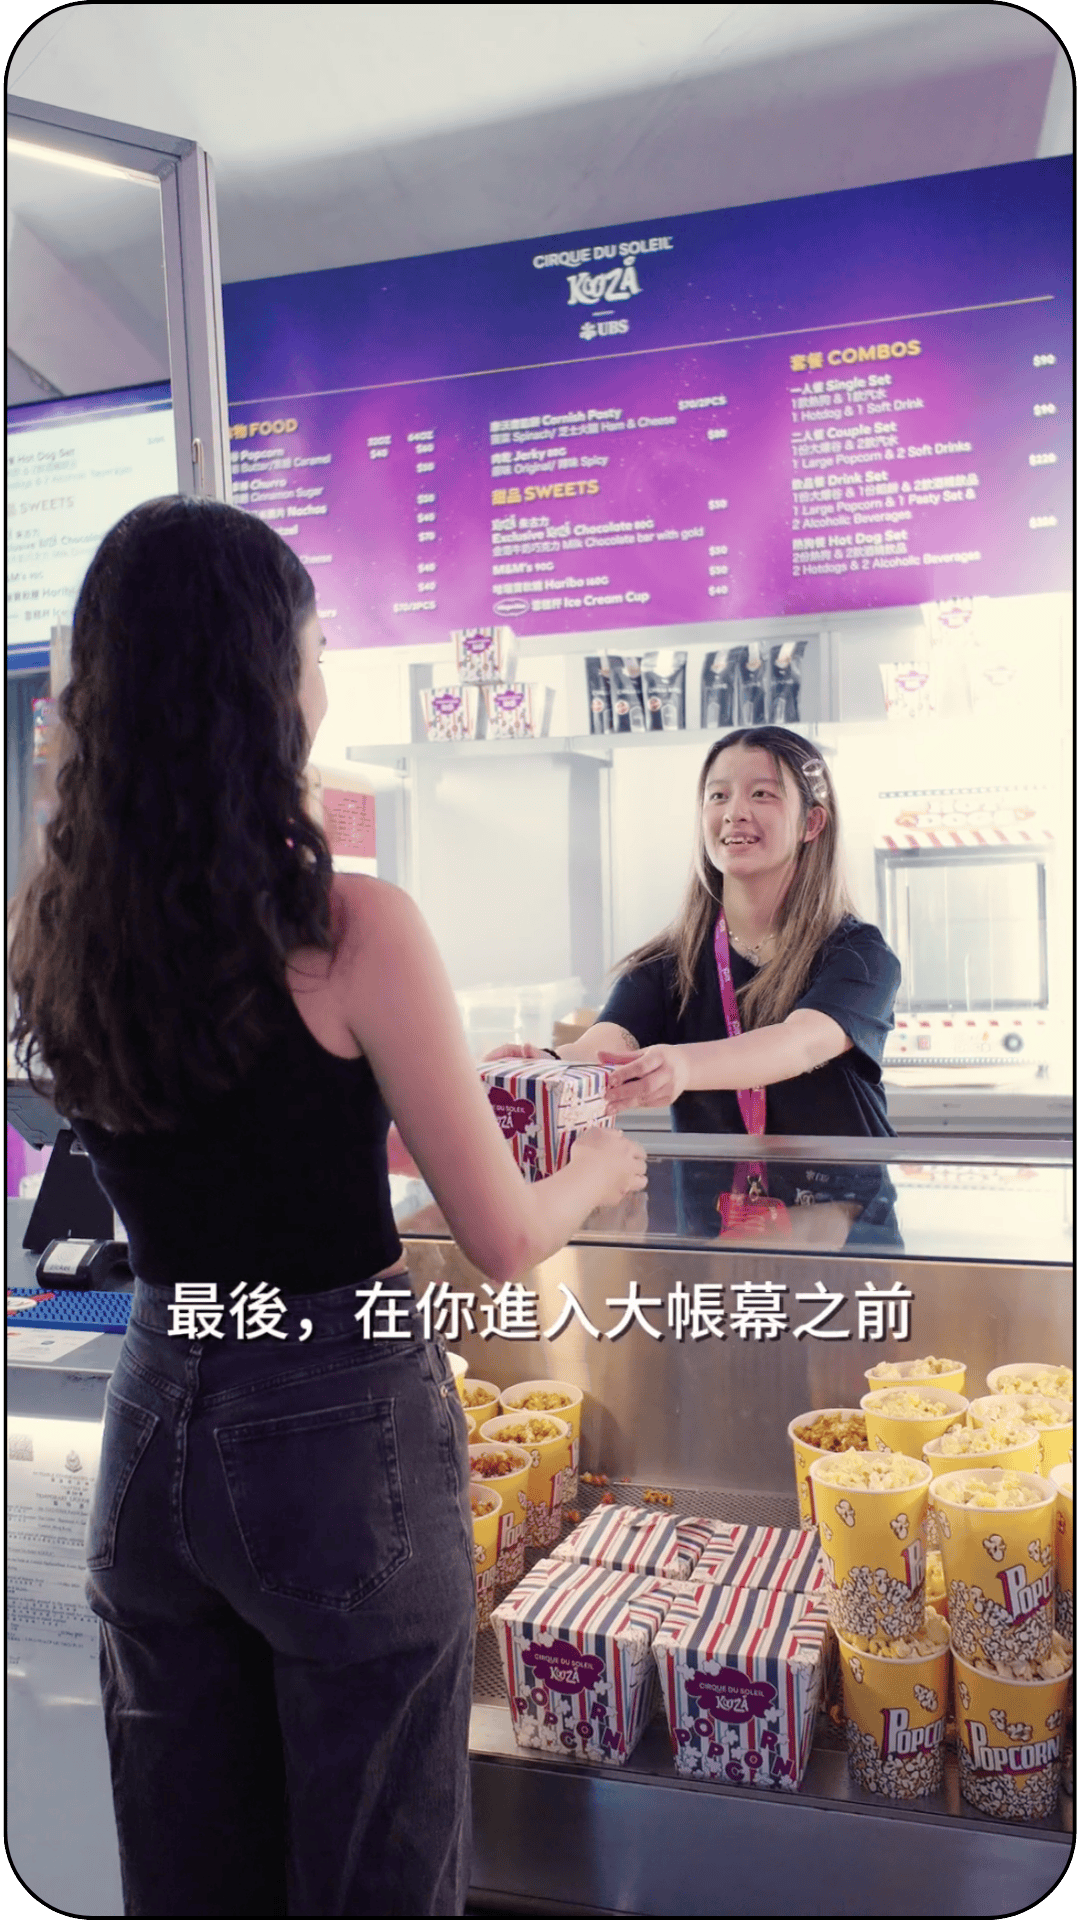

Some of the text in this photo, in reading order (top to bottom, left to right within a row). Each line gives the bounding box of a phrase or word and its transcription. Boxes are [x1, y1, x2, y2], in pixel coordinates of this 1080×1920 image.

[533, 236, 674, 269] CIRQUE DU SOLEIL
[597, 319, 629, 337] UBS
[827, 339, 922, 366] COMBOS
[826, 376, 866, 393] Single
[868, 373, 892, 387] Set
[833, 393, 843, 405] &
[587, 408, 622, 421] Pasty
[801, 408, 842, 422] Hotdog
[844, 405, 854, 417] &
[867, 400, 892, 415] Soft
[893, 397, 924, 411] Drink
[249, 418, 298, 437] FOOD
[826, 424, 871, 439] Couple
[874, 421, 897, 434] Set
[845, 440, 853, 451] &
[802, 457, 834, 470] Large
[836, 451, 882, 466] Popcorn
[884, 449, 894, 460] &
[897, 447, 906, 459] 2
[908, 444, 933, 458] Soft
[934, 441, 972, 454] Drinks
[827, 472, 862, 486] Drink
[865, 470, 889, 483] Set
[523, 479, 600, 502] SWEETS
[845, 487, 855, 498] &
[901, 480, 912, 492] &
[20, 495, 75, 515] SWEETS
[802, 504, 834, 516] Large
[836, 499, 883, 513] Popcorn
[884, 496, 895, 508] &
[908, 493, 941, 506] Pasty
[943, 489, 963, 502] Set
[965, 487, 976, 500] &
[792, 510, 912, 530] 2 Alcoholic Beverages
[491, 530, 545, 544] Exclusive
[573, 521, 633, 537] Chocolate
[585, 534, 635, 548] Chocolate
[681, 526, 705, 541] gold
[828, 534, 852, 547] Hot
[855, 532, 883, 546] Dog
[884, 529, 908, 542] Set
[834, 548, 843, 560] &
[793, 564, 800, 576] 2
[802, 562, 847, 576] Hotdogs
[850, 560, 859, 571] &
[862, 558, 870, 570] 2
[872, 556, 921, 569] Alcoholic
[544, 577, 585, 590] Haribo
[563, 597, 582, 608] Ice
[584, 594, 624, 607] Cream
[625, 591, 650, 605] Cup
[534, 1653, 594, 1671] CIRQUE DU SOLEIL
[699, 1682, 765, 1698] CIRQUE DU SOLEIL
